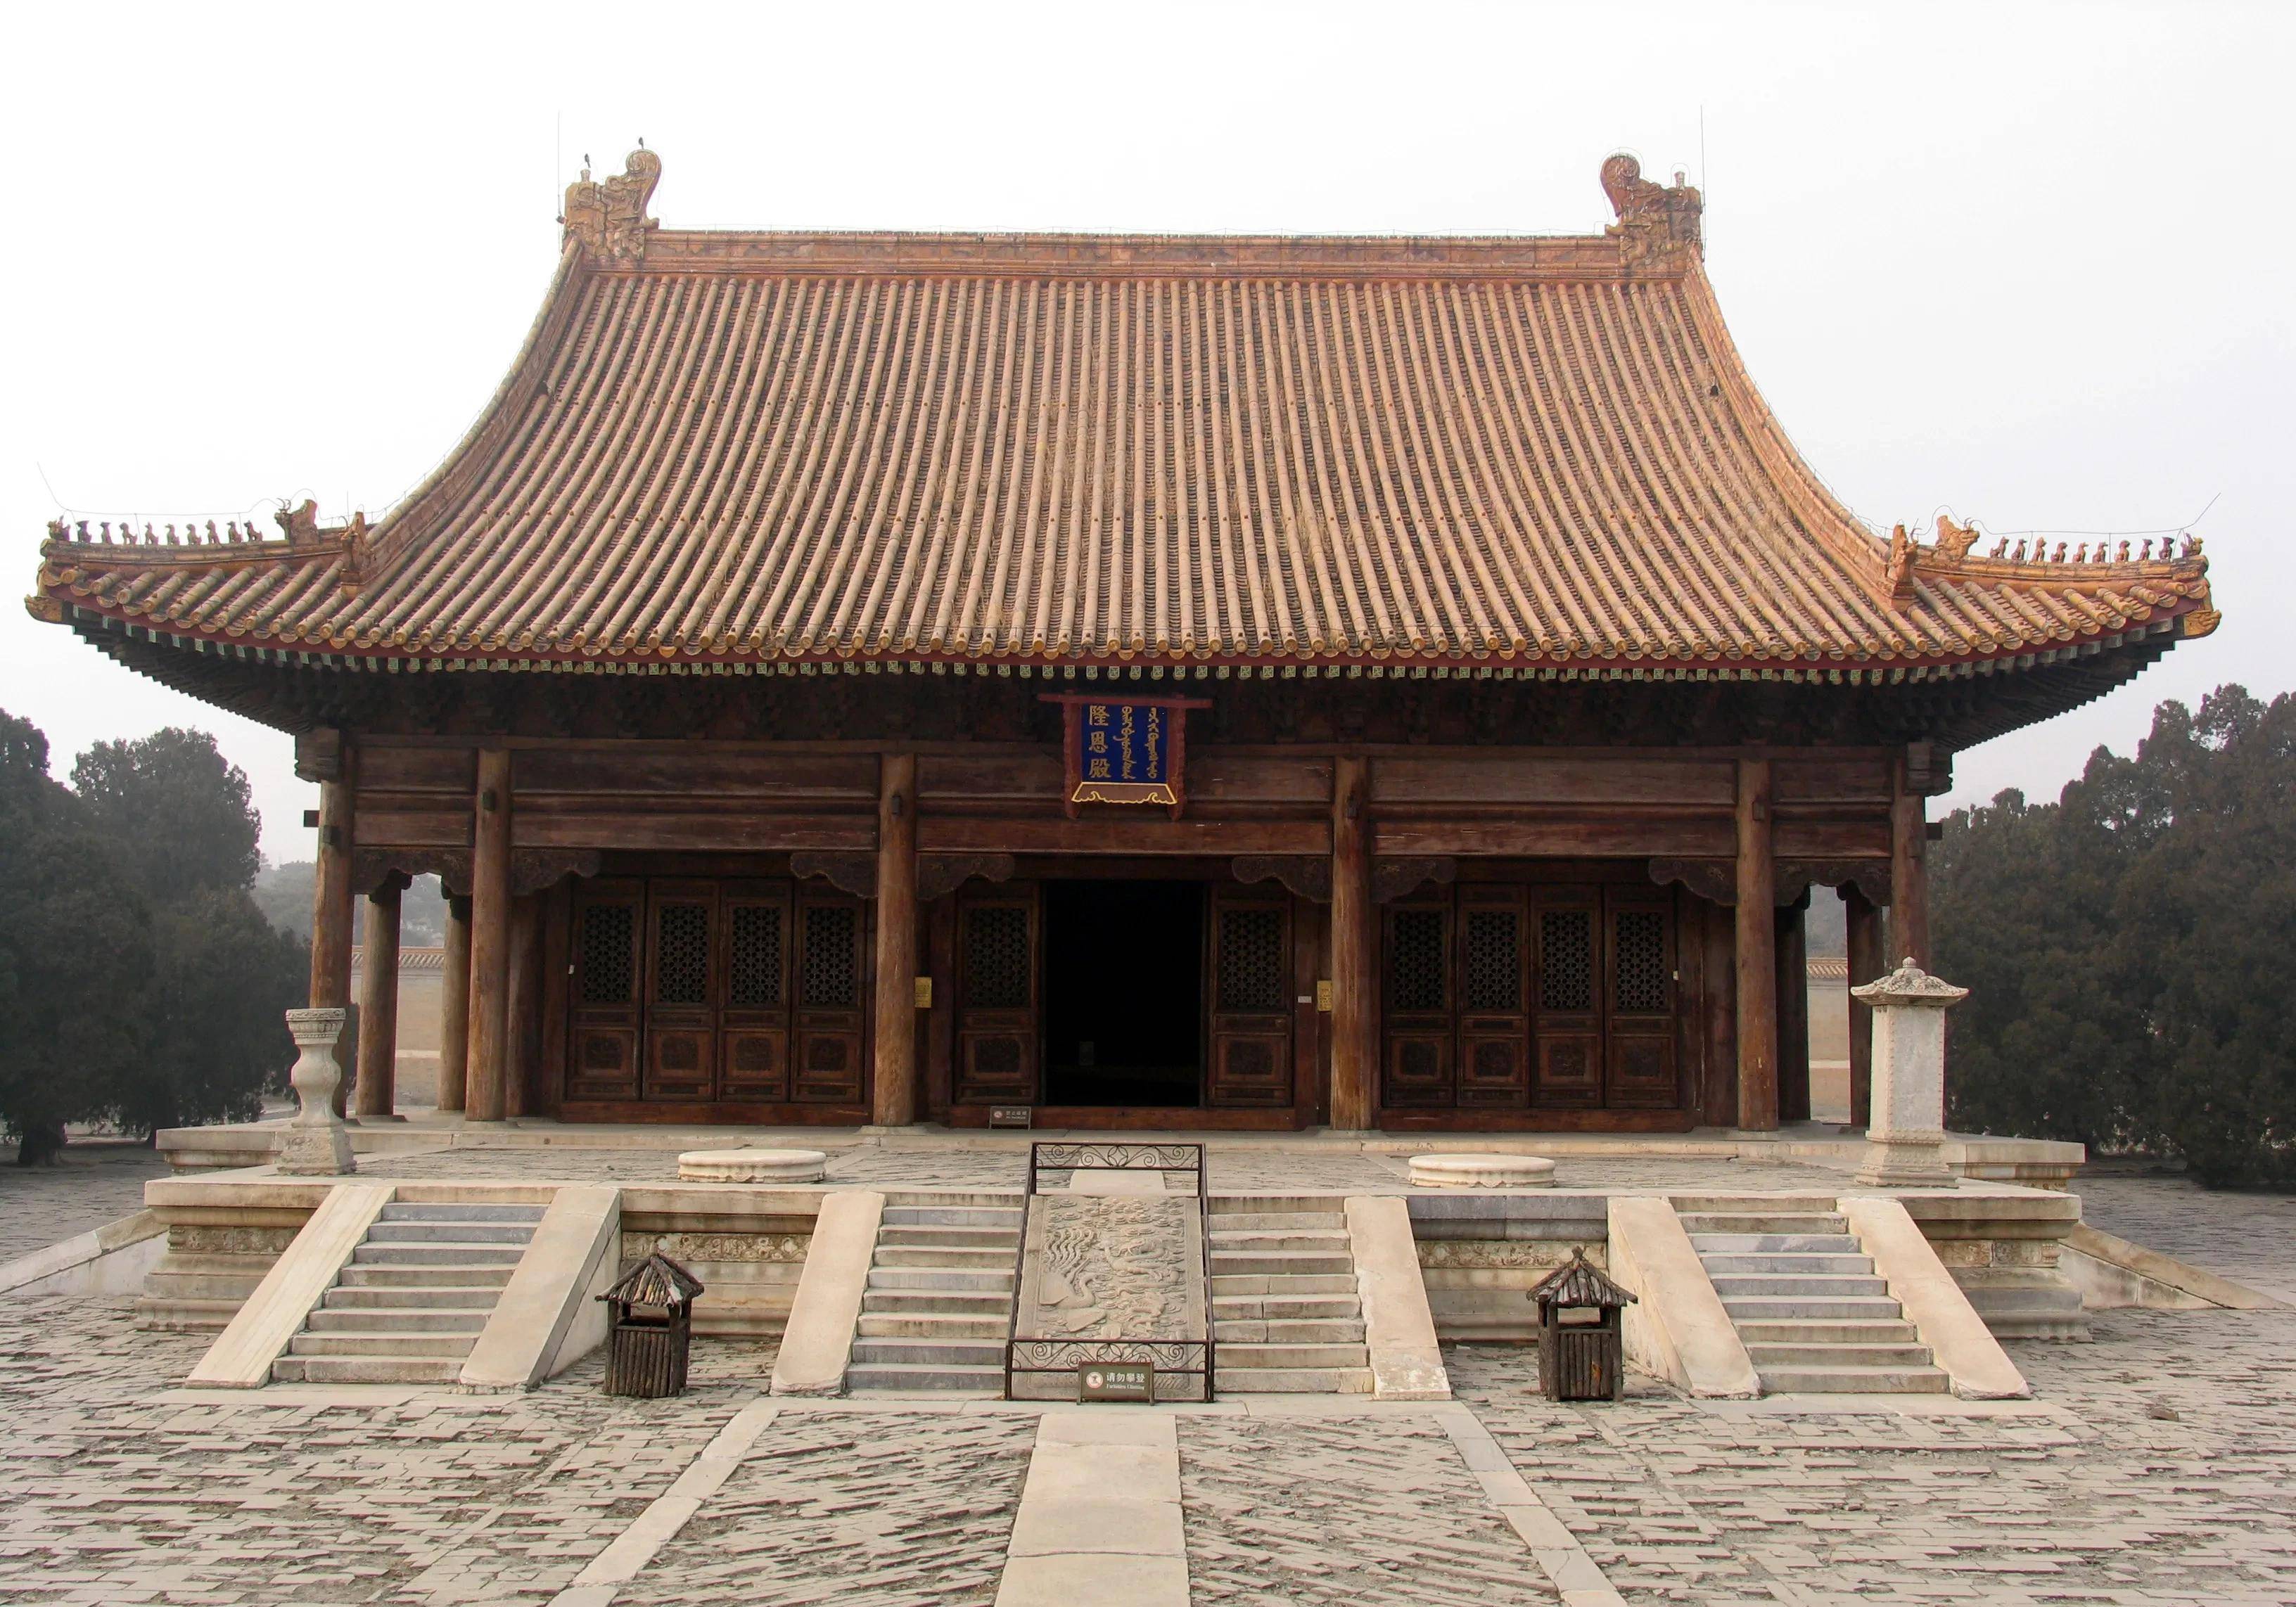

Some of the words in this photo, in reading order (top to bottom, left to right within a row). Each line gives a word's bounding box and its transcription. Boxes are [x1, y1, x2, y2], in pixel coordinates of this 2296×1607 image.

[1089, 705, 1112, 779] 隆恩殿
[1106, 1372, 1145, 1383] 请勿攀登
